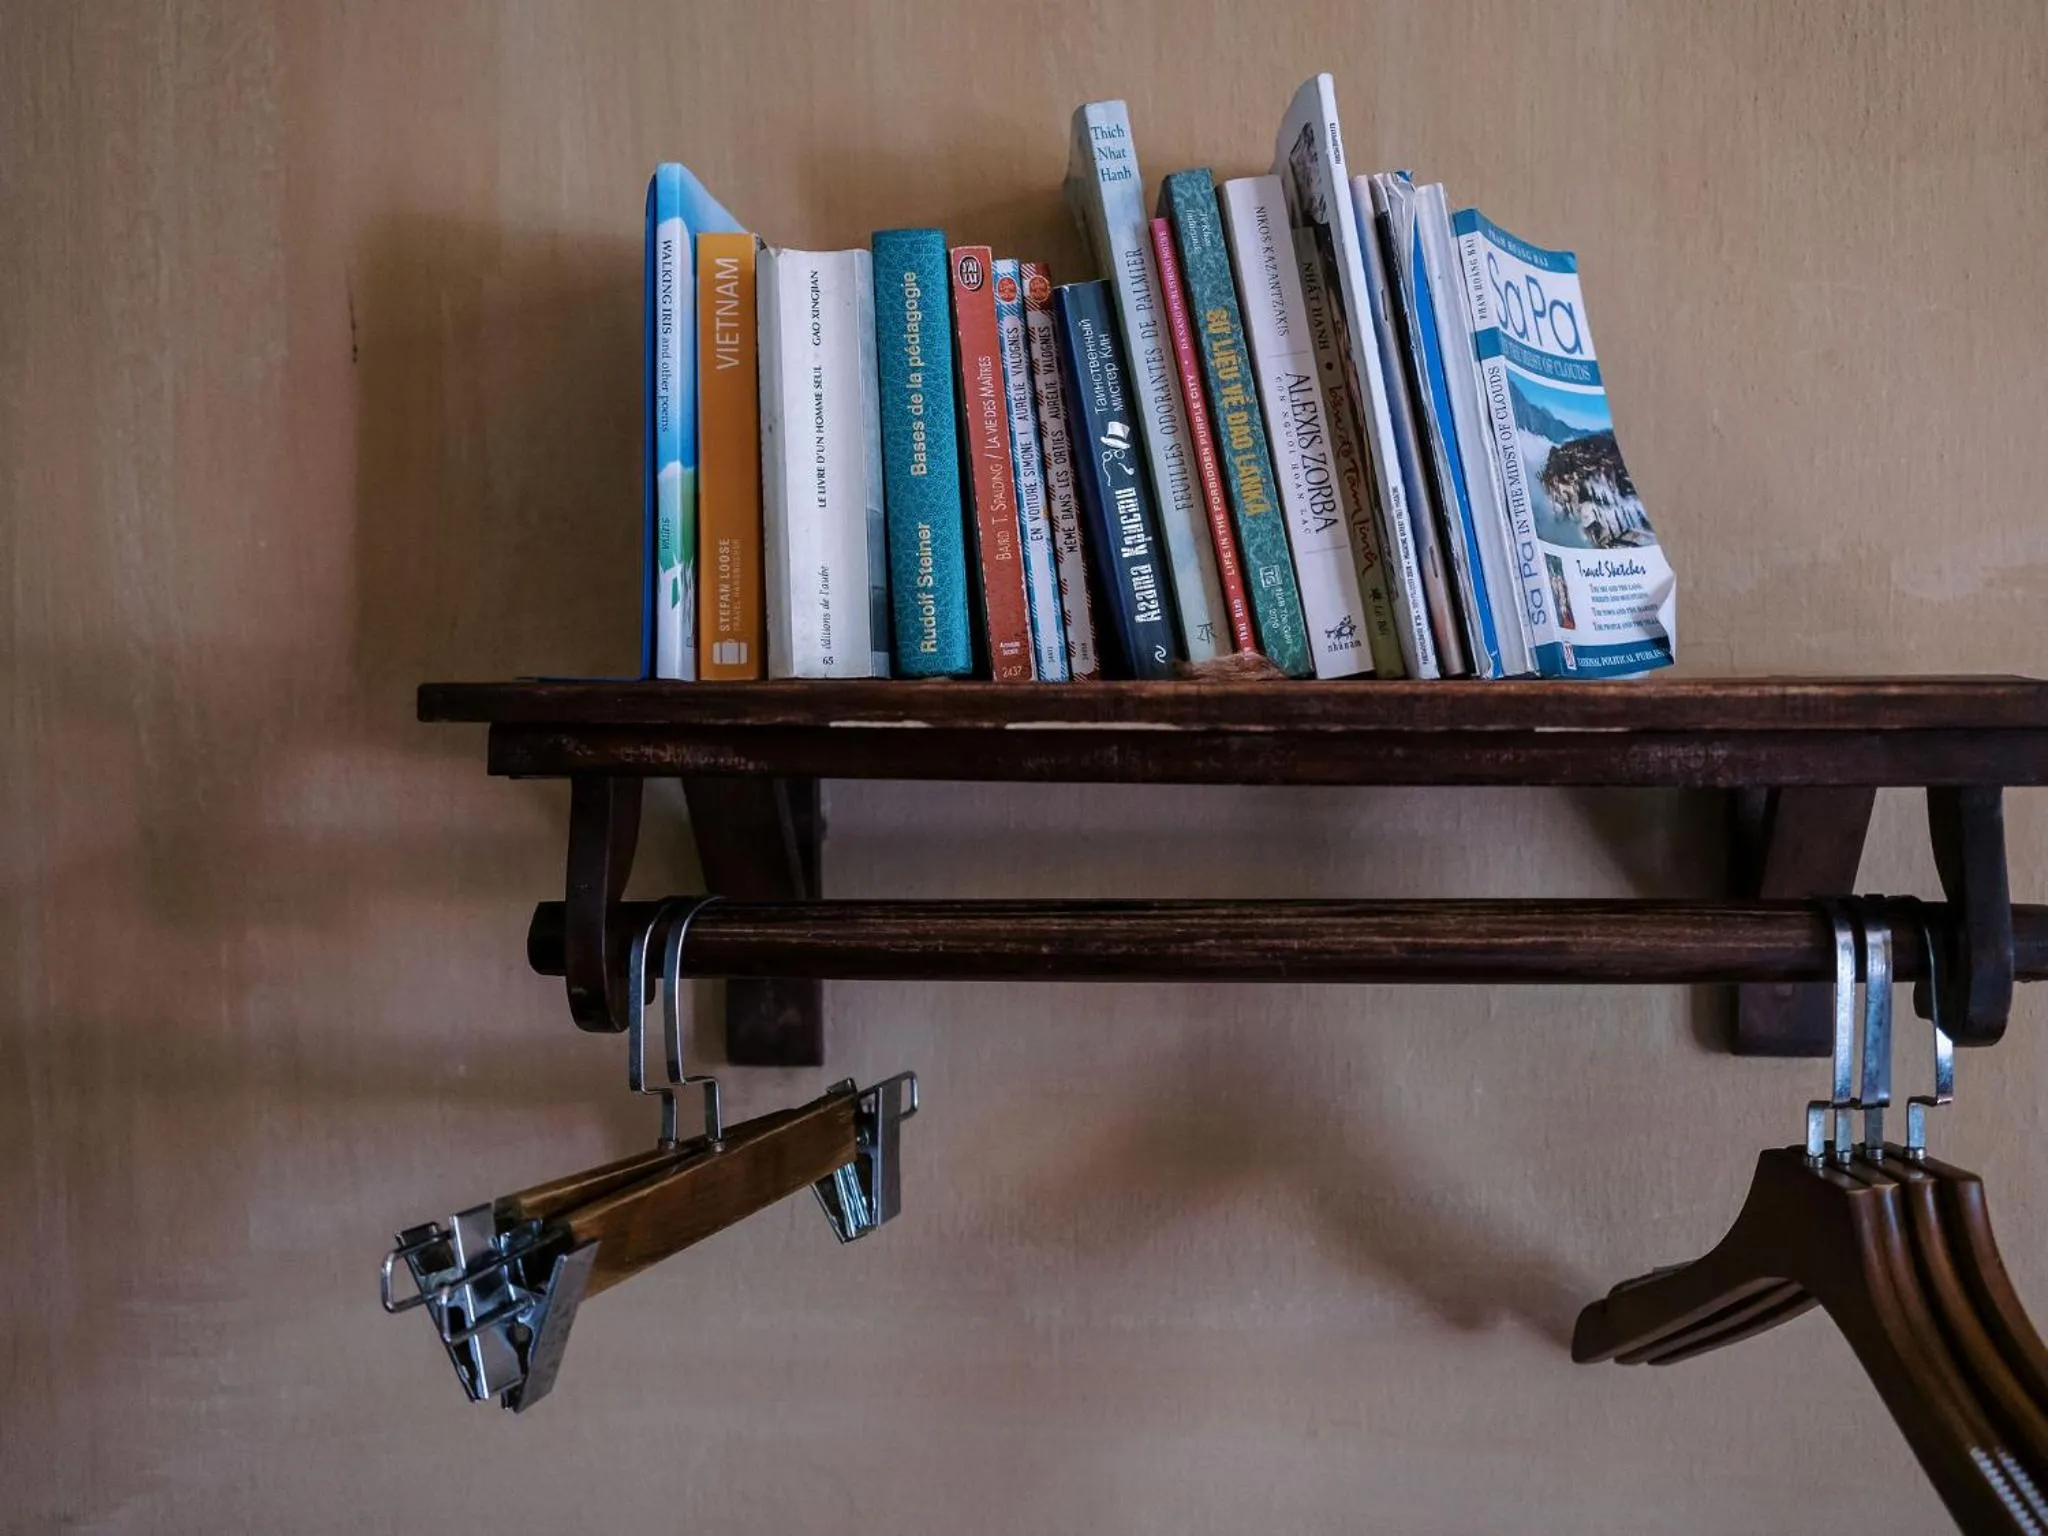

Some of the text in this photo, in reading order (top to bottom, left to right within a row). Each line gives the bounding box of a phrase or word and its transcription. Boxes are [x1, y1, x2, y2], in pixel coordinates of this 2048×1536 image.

[1091, 124, 1125, 142] Thich
[1097, 147, 1126, 161] Nhat
[1100, 168, 1132, 183] Hanh
[1255, 206, 1289, 337] NIKOS KAZANTZAKIS
[715, 257, 740, 370] VIETNAM
[810, 270, 821, 346] GAO XINGJIAN
[657, 239, 672, 433] WALKING IRIS and other poems
[1006, 327, 1024, 377] VALOGNES
[1038, 326, 1056, 378] VALOGNES
[901, 271, 927, 476] Bases de la pédagogie
[1078, 318, 1103, 415] Таинственный
[1099, 333, 1125, 412] мистер Кин
[1125, 248, 1193, 512] FEUILLES ODORANTES DE PALMIER
[1554, 360, 1591, 381] CLOUDS
[813, 365, 827, 508] LE LIVRE D'UN HOMME SEUL
[1021, 440, 1036, 478] SIMONE
[1051, 429, 1068, 463] ORTIES
[1286, 373, 1341, 534] ALEXIS ZORBA
[1058, 470, 1070, 489] LES
[1191, 374, 1236, 575] LIFE IN THE FORBIDDEN PURPLE CITY
[1487, 366, 1547, 625] Sa Pa IN THE MIDST OF CLOUDS
[1059, 493, 1075, 521] DANS
[1030, 525, 1043, 542] EN
[1114, 487, 1163, 623] Агата Кристи
[718, 538, 731, 631] STEFAN LOOSE
[916, 521, 936, 653] Rudolf Steiner
[1577, 559, 1646, 577] Travel Sketches
[821, 594, 830, 610] de
[820, 608, 831, 649] éditions
[822, 656, 834, 665] 65
[1003, 665, 1022, 678] 2437
